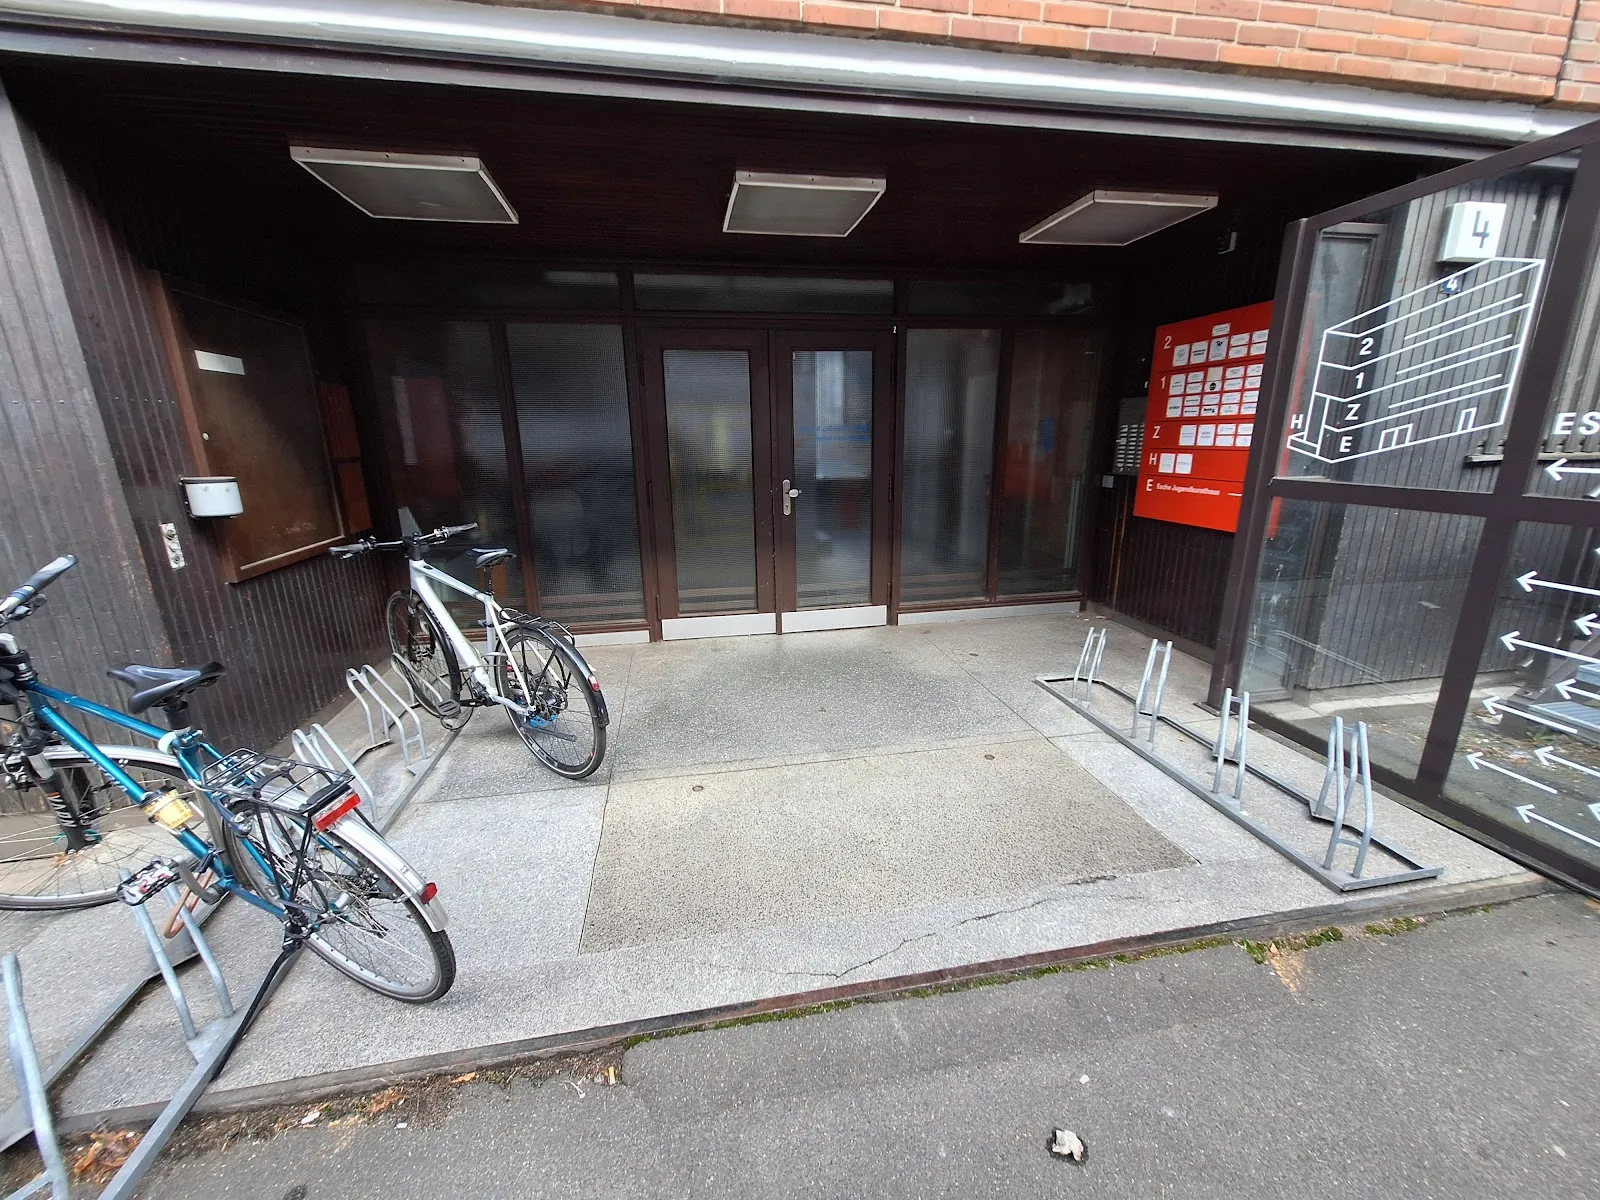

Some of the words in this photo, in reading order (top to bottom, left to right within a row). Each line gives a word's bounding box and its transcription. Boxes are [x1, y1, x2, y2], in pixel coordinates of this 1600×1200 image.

[1472, 210, 1490, 248] 4
[1446, 278, 1458, 291] 4
[1163, 335, 1172, 349] 2
[1359, 337, 1374, 355] 2
[1160, 376, 1166, 389] 1
[1355, 372, 1365, 389] 1
[1344, 403, 1361, 420] Z
[1290, 413, 1304, 429] H
[1152, 426, 1160, 439] Z
[1339, 436, 1353, 453] E
[1149, 453, 1157, 465] H
[1146, 479, 1154, 491] E
